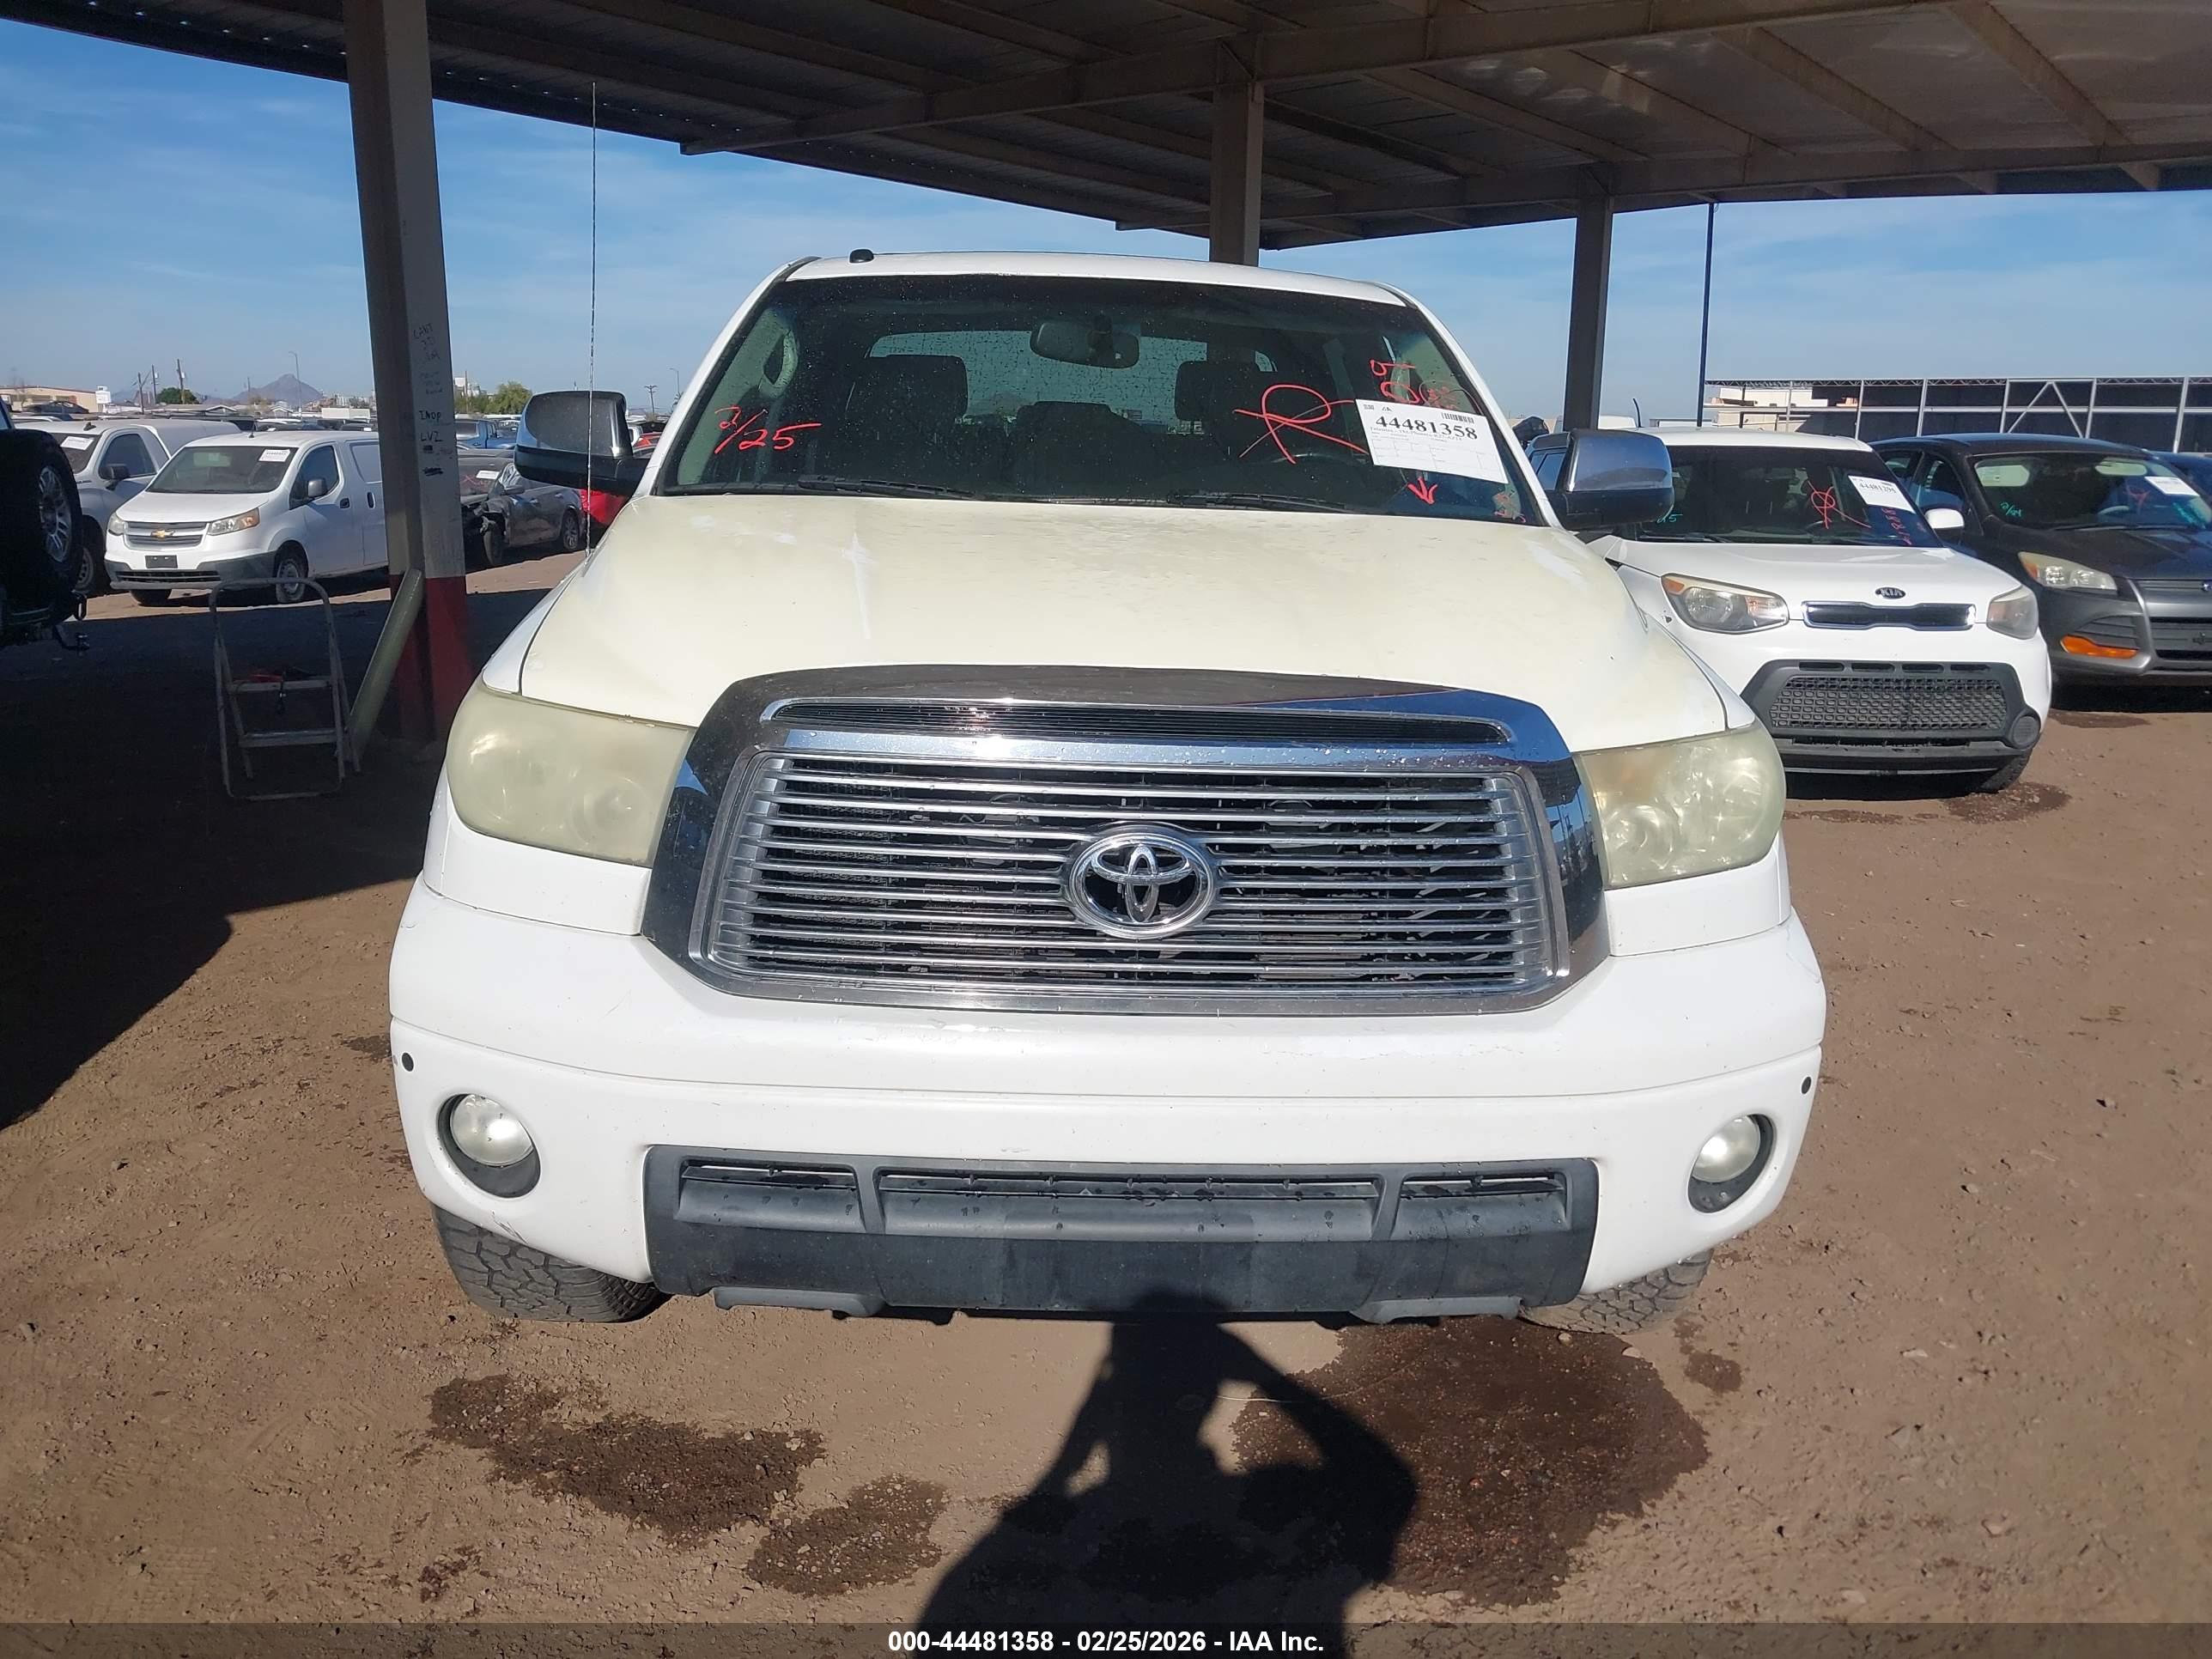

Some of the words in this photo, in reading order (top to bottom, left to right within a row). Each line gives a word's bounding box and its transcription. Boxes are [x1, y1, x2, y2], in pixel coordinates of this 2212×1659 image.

[714, 404, 823, 454] 2/25
[1375, 416, 1479, 441] 44481358
[1880, 588, 1903, 597] KIA
